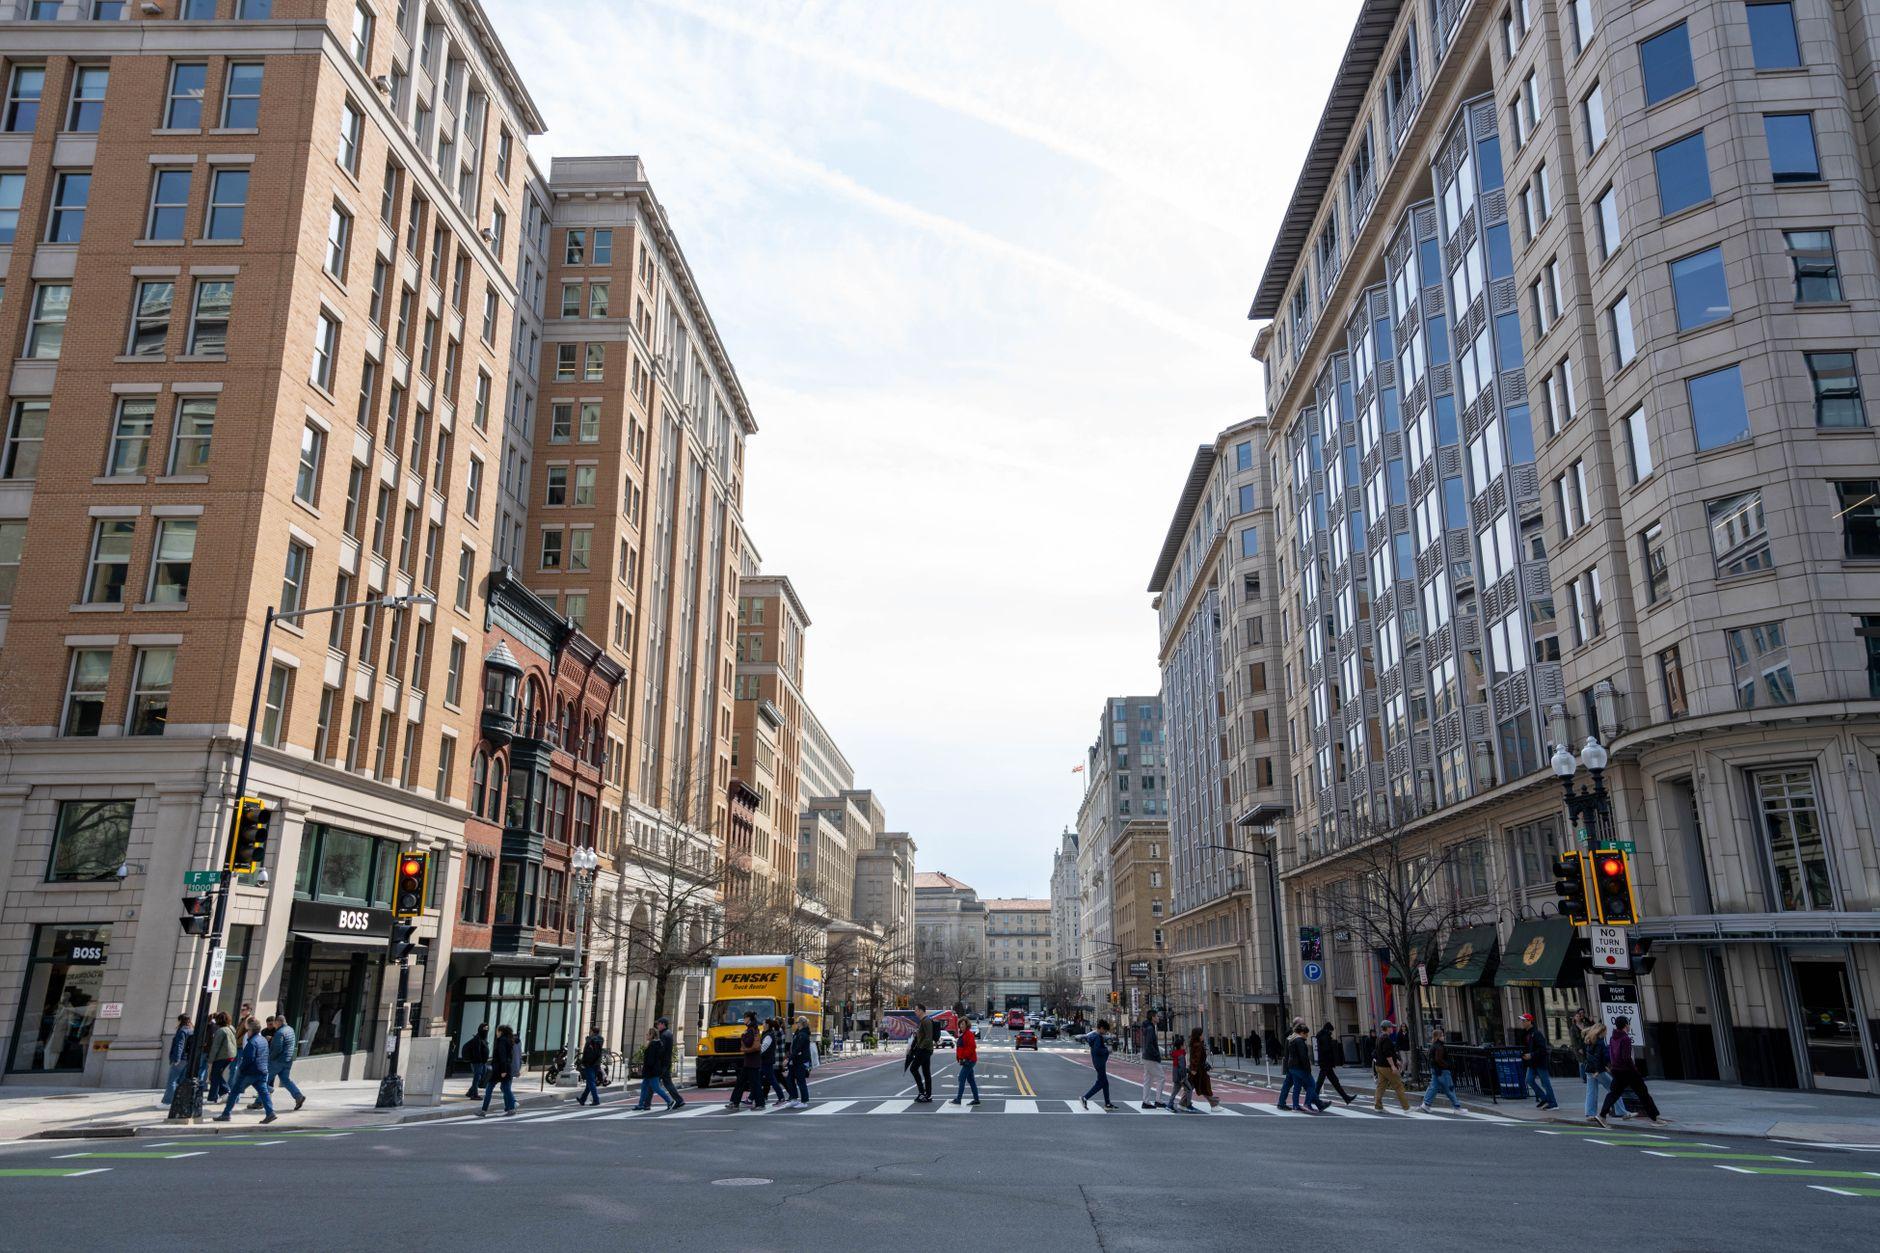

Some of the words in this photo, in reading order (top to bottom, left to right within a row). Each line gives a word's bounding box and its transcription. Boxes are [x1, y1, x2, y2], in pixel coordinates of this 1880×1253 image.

[193, 872, 202, 882] F
[339, 910, 369, 930] BOSS
[1600, 928, 1616, 937] NO
[1599, 938, 1620, 946] TURN
[73, 946, 102, 959] BOSS
[1594, 946, 1607, 954] ON
[1609, 947, 1625, 955] RED
[1309, 965, 1319, 978] P
[721, 972, 780, 984] PENSKE
[1606, 1005, 1634, 1015] BUSES
[1610, 1016, 1632, 1026] OY
